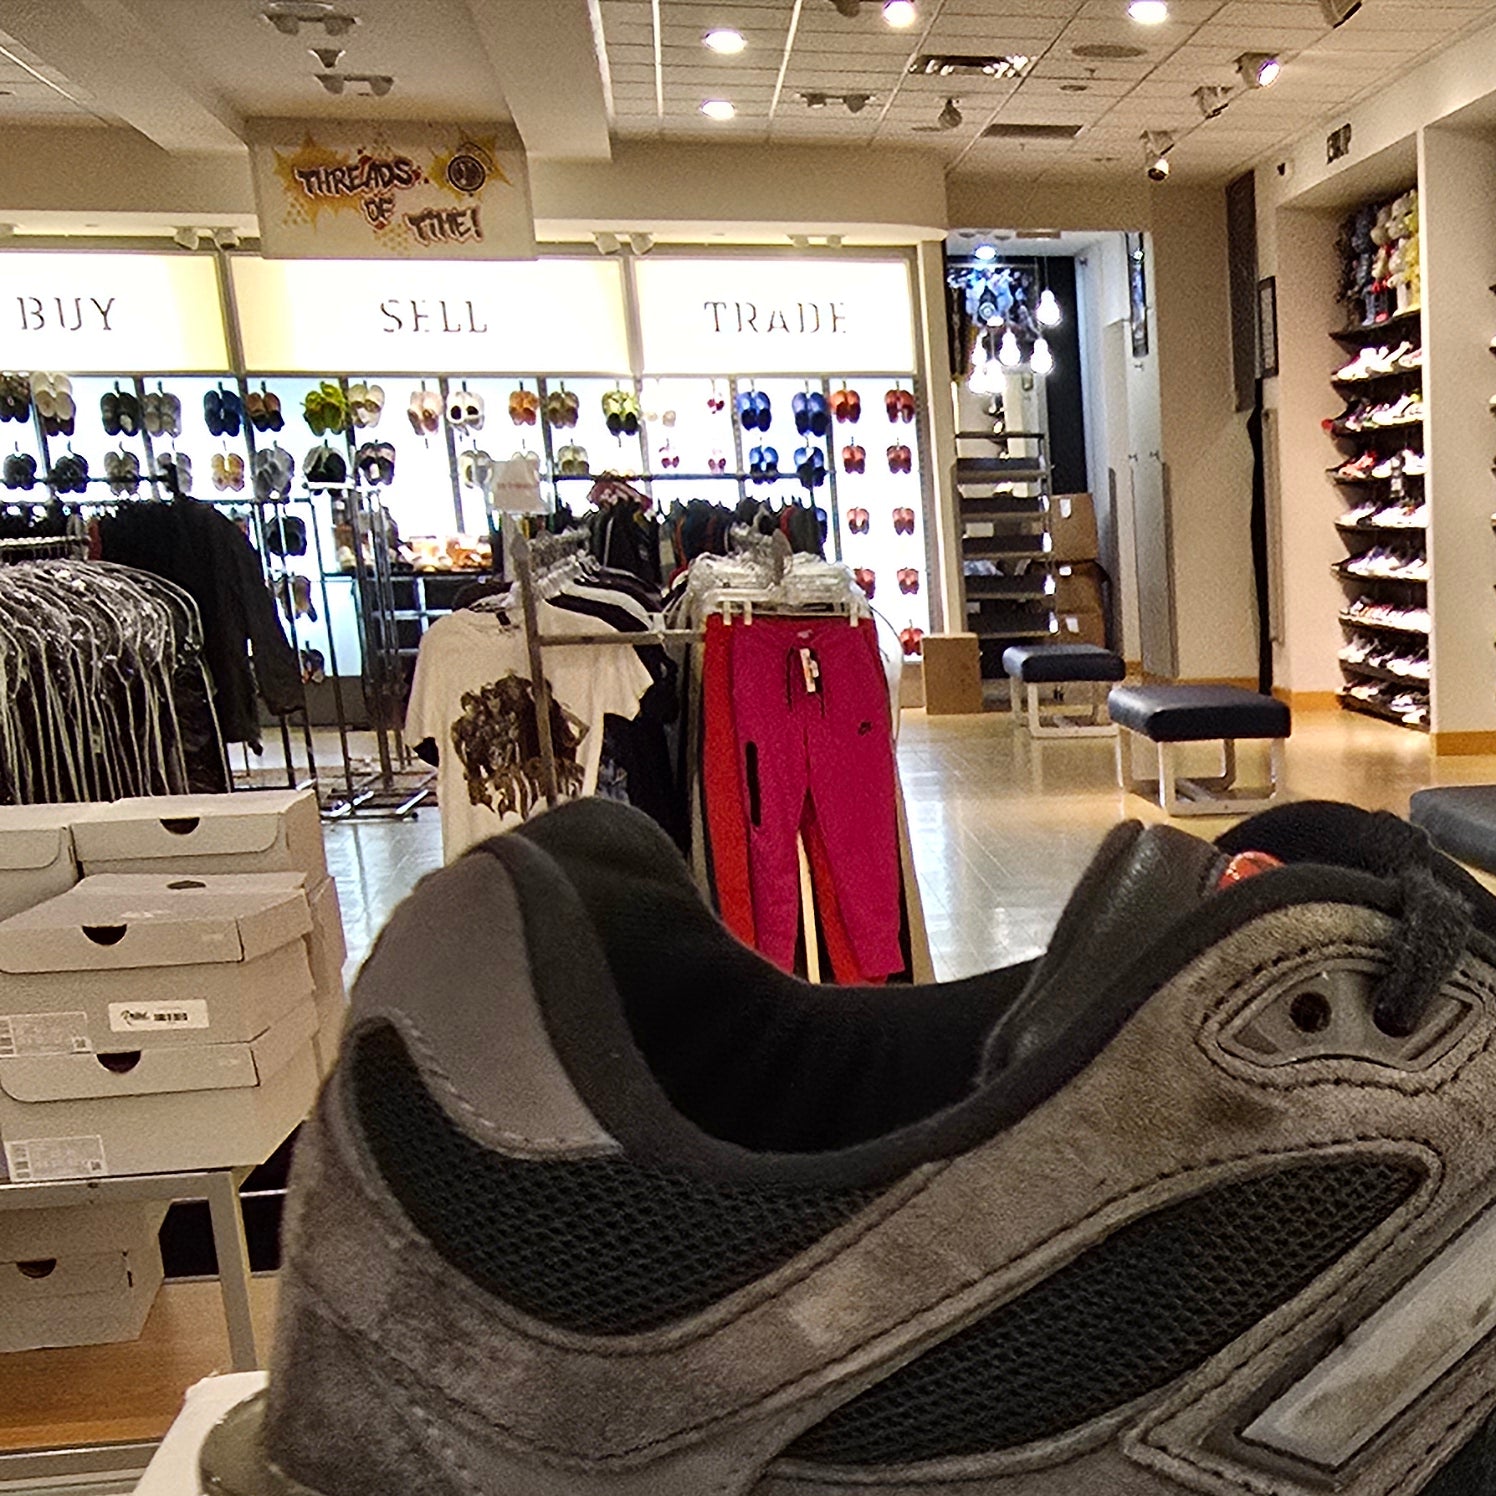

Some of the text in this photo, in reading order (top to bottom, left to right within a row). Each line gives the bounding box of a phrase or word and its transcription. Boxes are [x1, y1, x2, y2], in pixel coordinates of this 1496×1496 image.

[295, 155, 416, 198] THREADS
[363, 196, 395, 226] OF
[16, 296, 116, 331] BUY
[380, 300, 488, 333] SELL
[703, 301, 847, 333] TRADE
